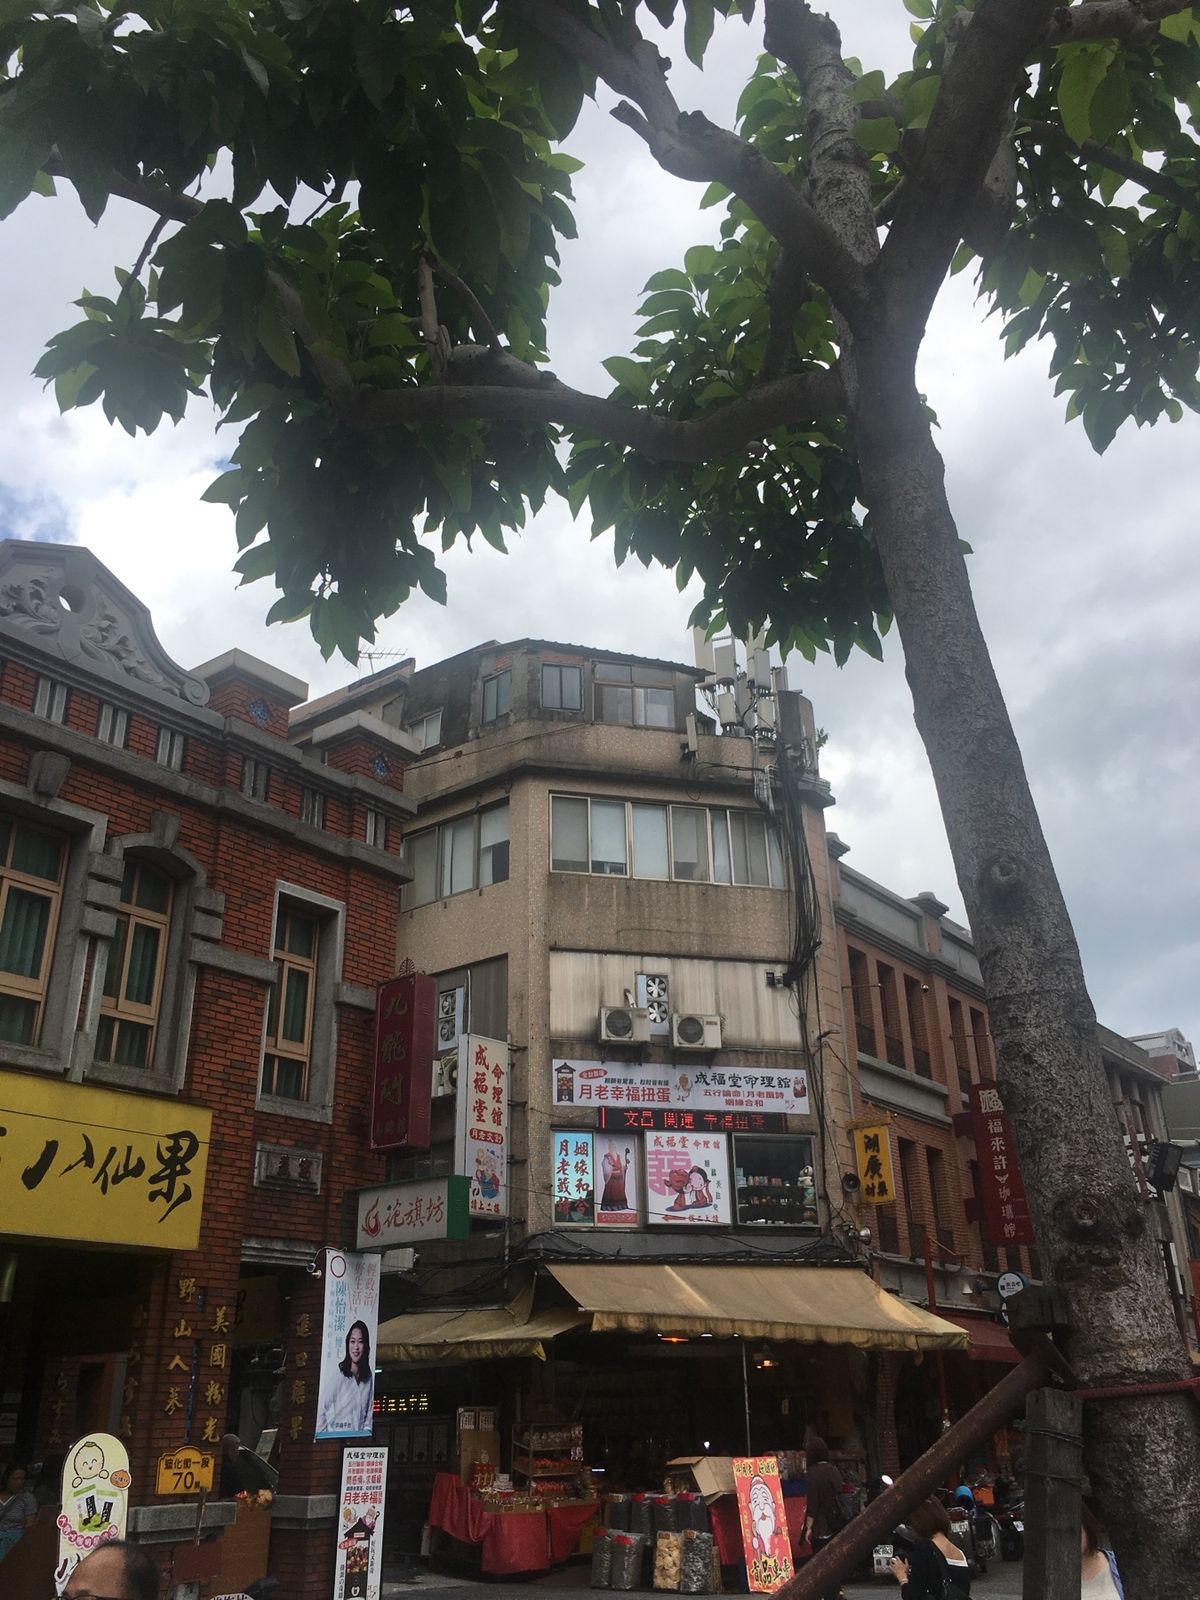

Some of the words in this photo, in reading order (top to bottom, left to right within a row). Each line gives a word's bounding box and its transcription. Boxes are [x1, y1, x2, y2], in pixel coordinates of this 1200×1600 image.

[472, 1043, 490, 1123] 成福堂
[578, 1083, 671, 1103] 月老幸福扭蛋
[653, 1135, 689, 1148] 成福堂
[987, 1118, 1008, 1171] 福來許
[0, 1126, 200, 1224] 八仙果
[384, 1194, 446, 1229] 花旗坊
[342, 1491, 378, 1505] 月老幸福
